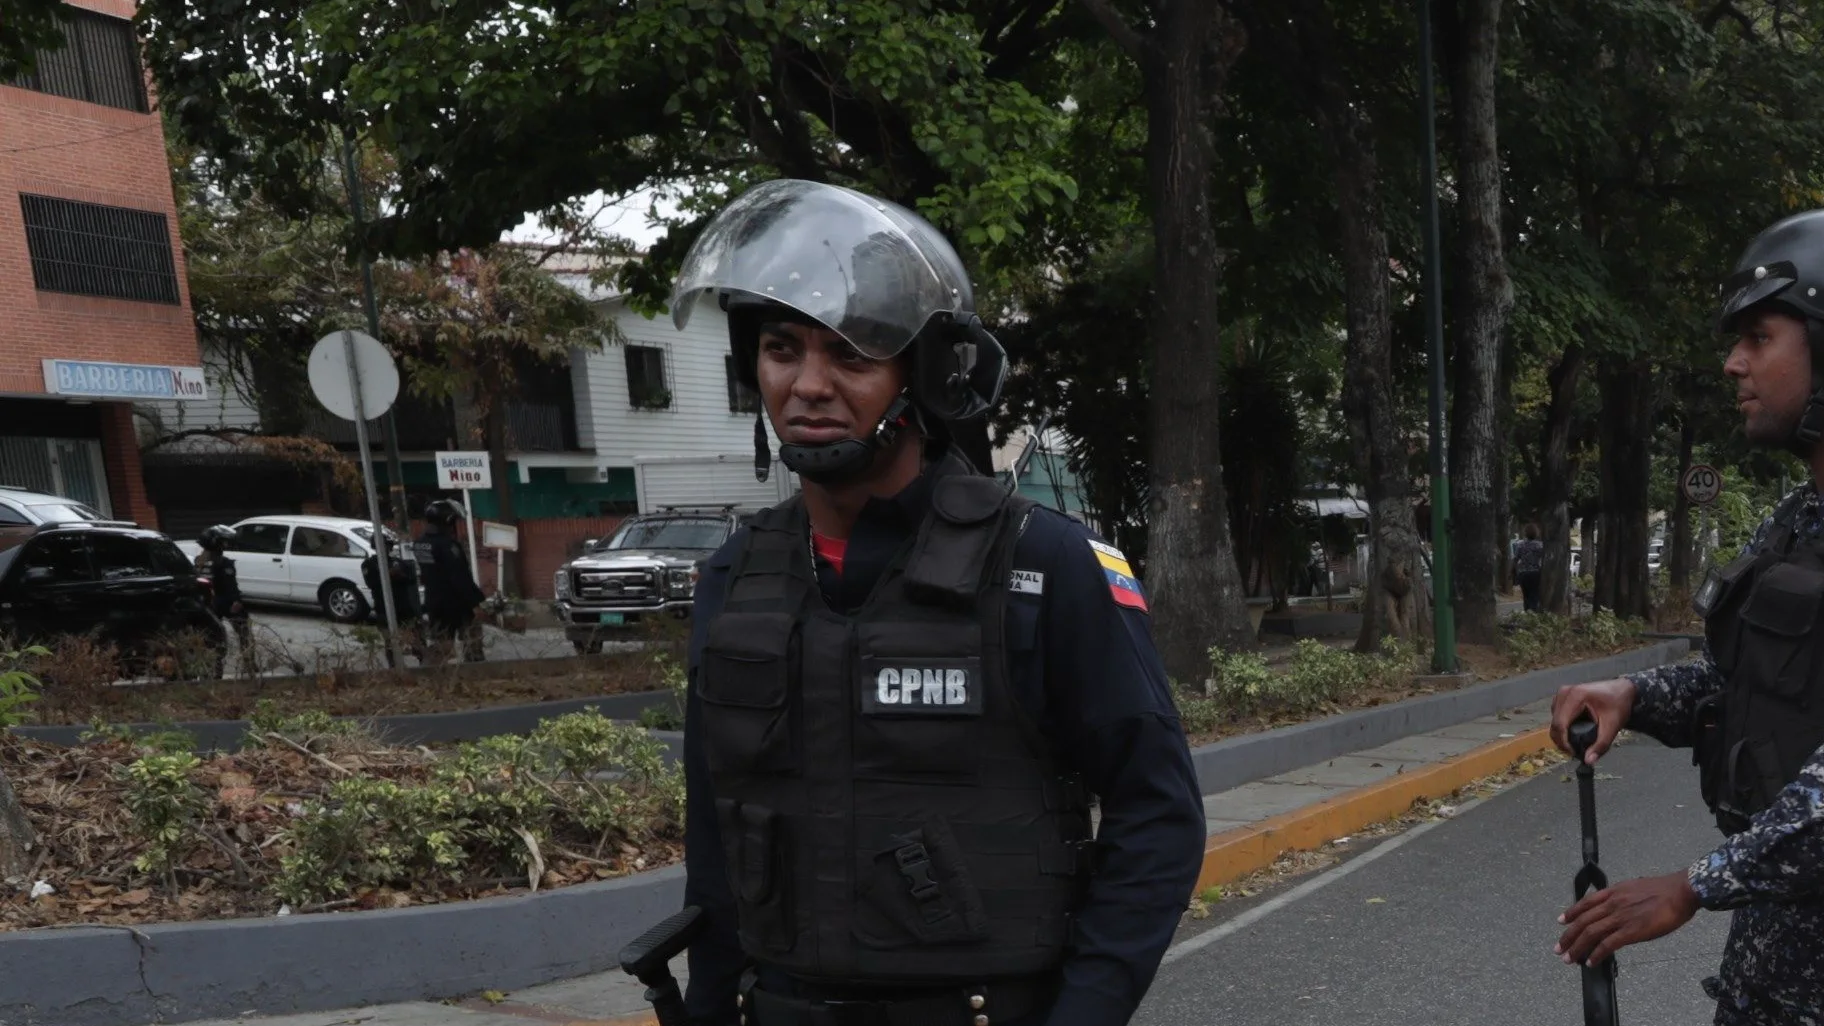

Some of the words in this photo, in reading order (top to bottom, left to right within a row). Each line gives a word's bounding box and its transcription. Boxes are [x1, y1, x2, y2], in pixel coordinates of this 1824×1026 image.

[58, 363, 169, 394] BARBERIA
[441, 457, 484, 469] BARBERIA
[1688, 471, 1714, 489] 40
[878, 667, 966, 705] CPNB
